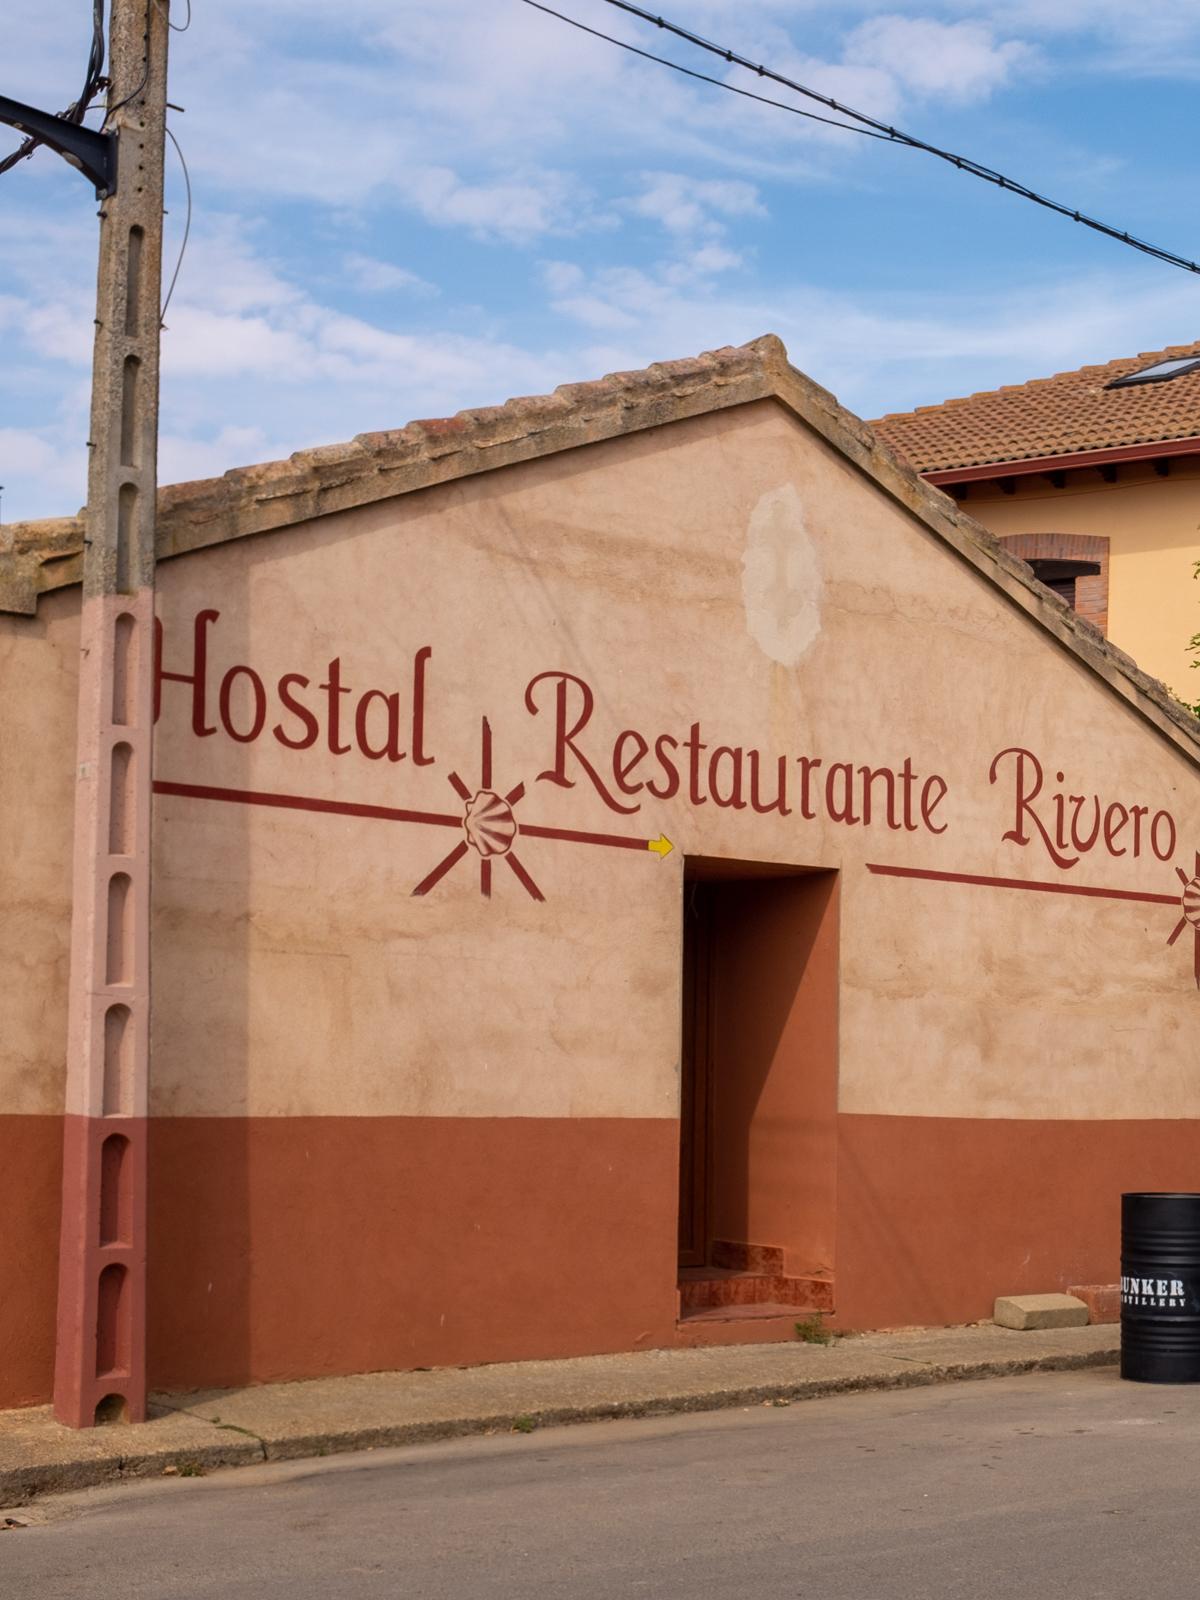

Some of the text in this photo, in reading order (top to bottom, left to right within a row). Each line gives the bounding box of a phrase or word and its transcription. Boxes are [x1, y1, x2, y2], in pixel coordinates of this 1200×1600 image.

[154, 608, 1176, 869] Hostal Restaurante Rivero
